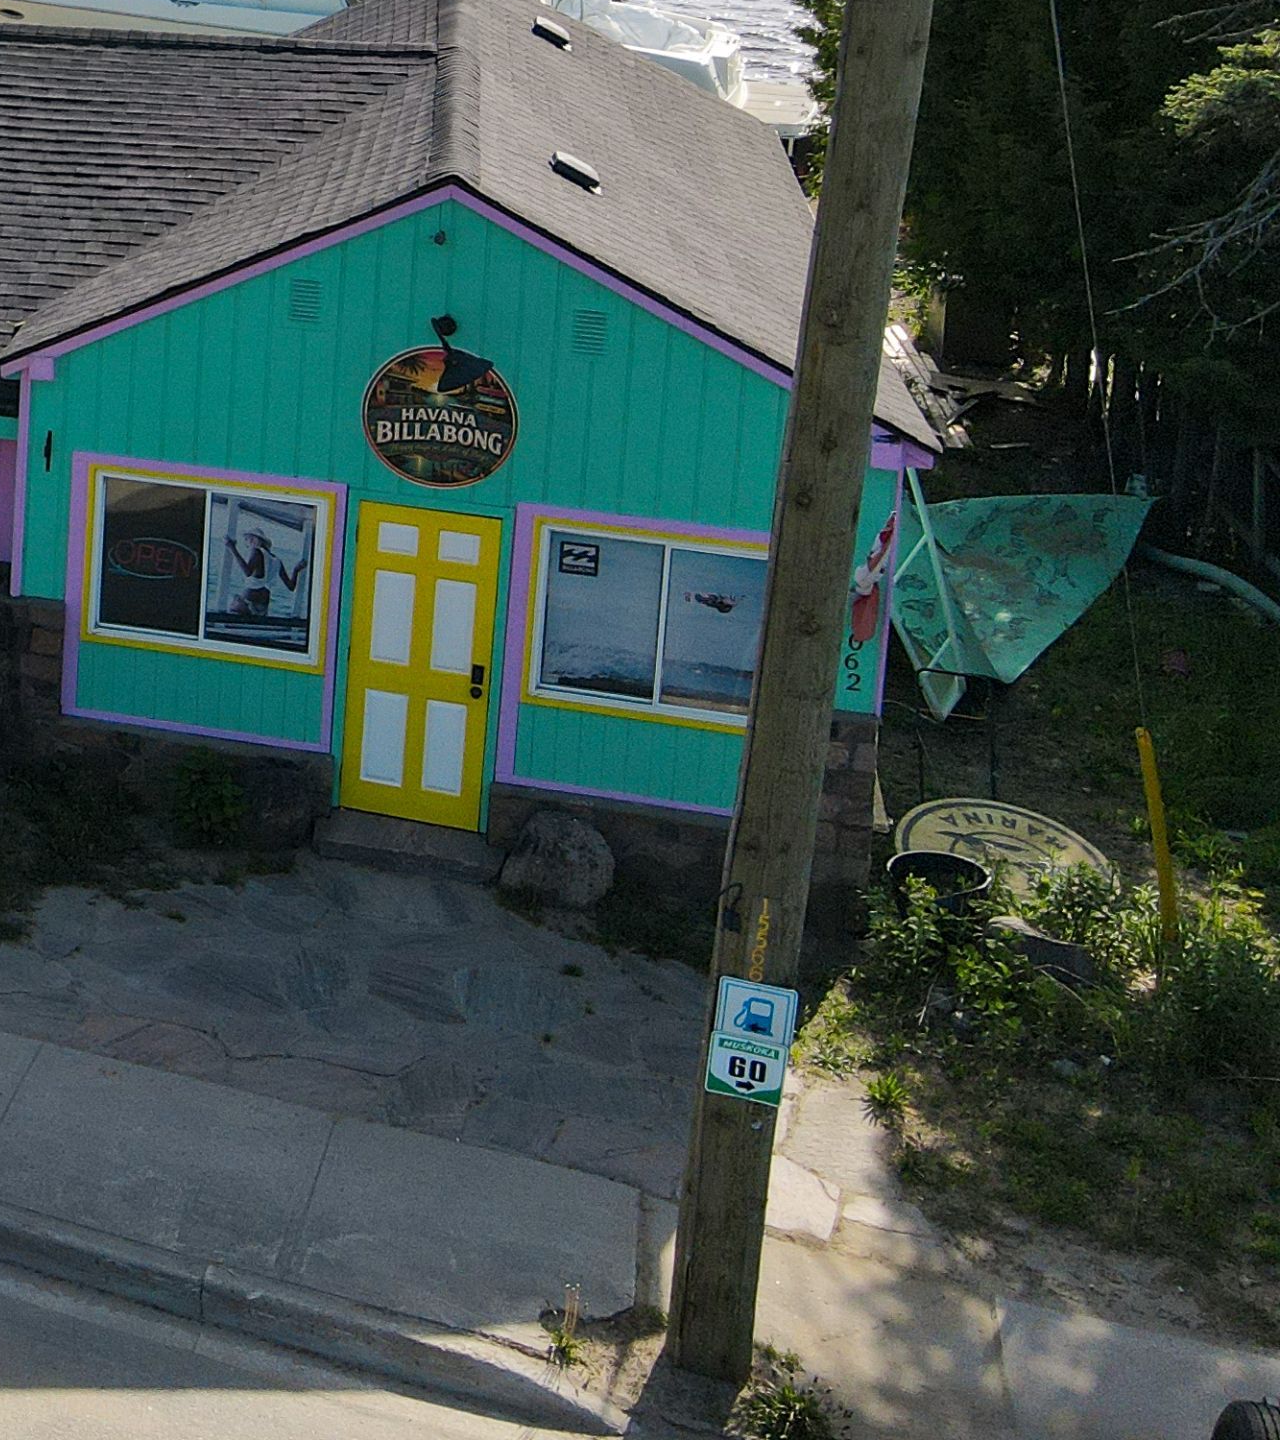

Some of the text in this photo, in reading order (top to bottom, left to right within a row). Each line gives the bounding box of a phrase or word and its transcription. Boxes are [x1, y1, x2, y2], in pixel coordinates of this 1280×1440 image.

[401, 407, 477, 428] HAVANA
[375, 420, 503, 456] BILLABONG
[114, 539, 192, 577] OPEN
[722, 1040, 776, 1059] MUSKOKA
[728, 1055, 767, 1083] 60
